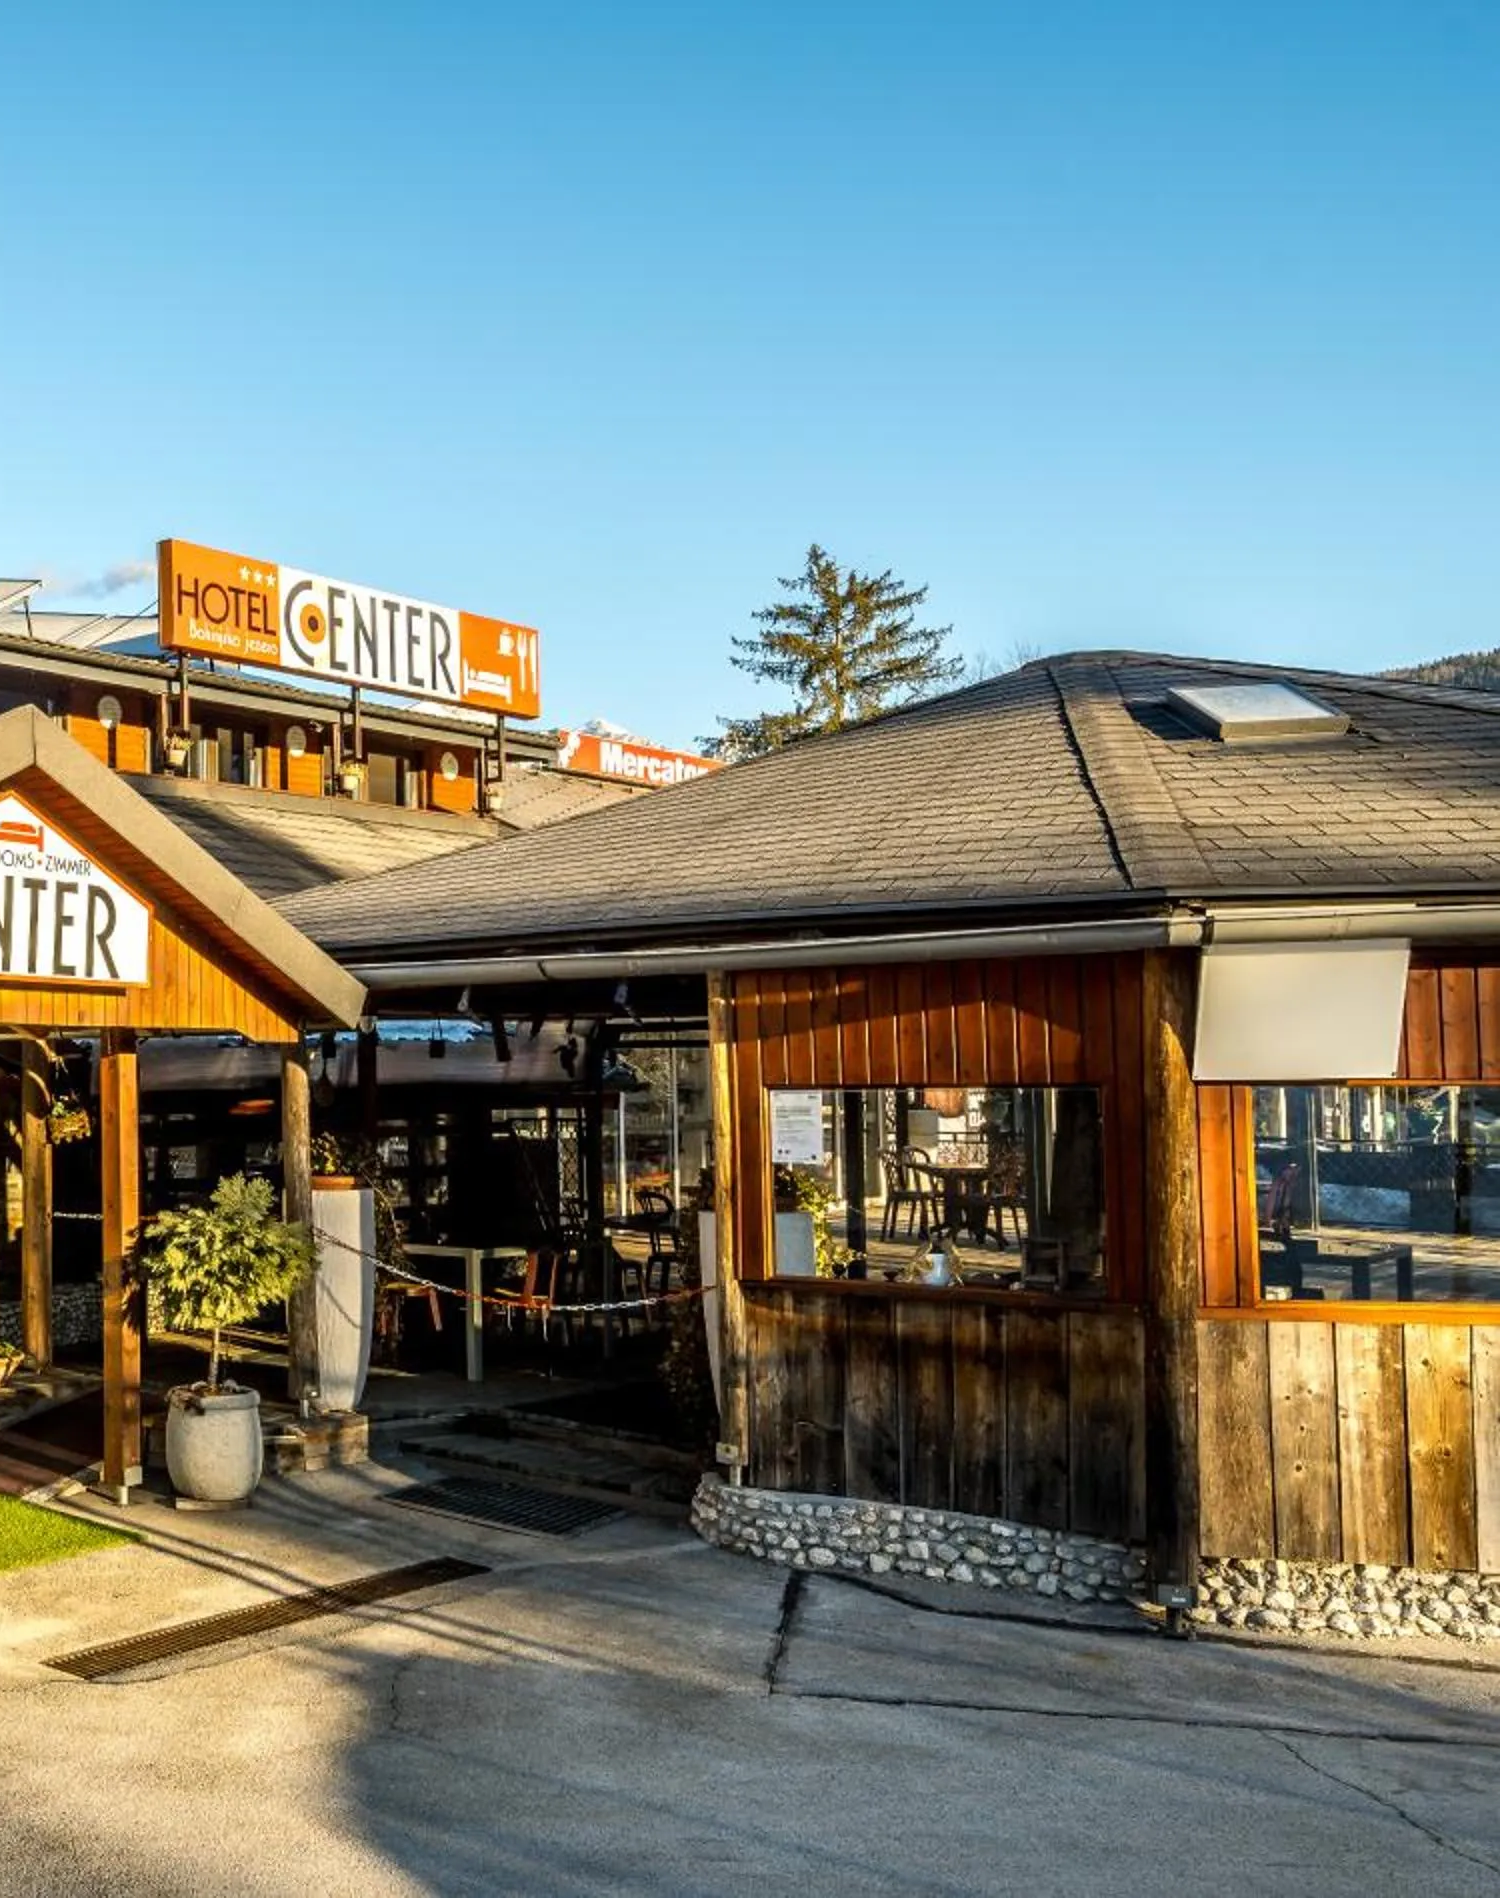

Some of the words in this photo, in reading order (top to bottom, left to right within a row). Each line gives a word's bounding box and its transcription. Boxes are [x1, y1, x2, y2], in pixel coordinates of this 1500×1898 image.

[177, 573, 276, 637] HOTEL
[284, 579, 457, 695] CENTER
[45, 854, 92, 877] ZIMMER
